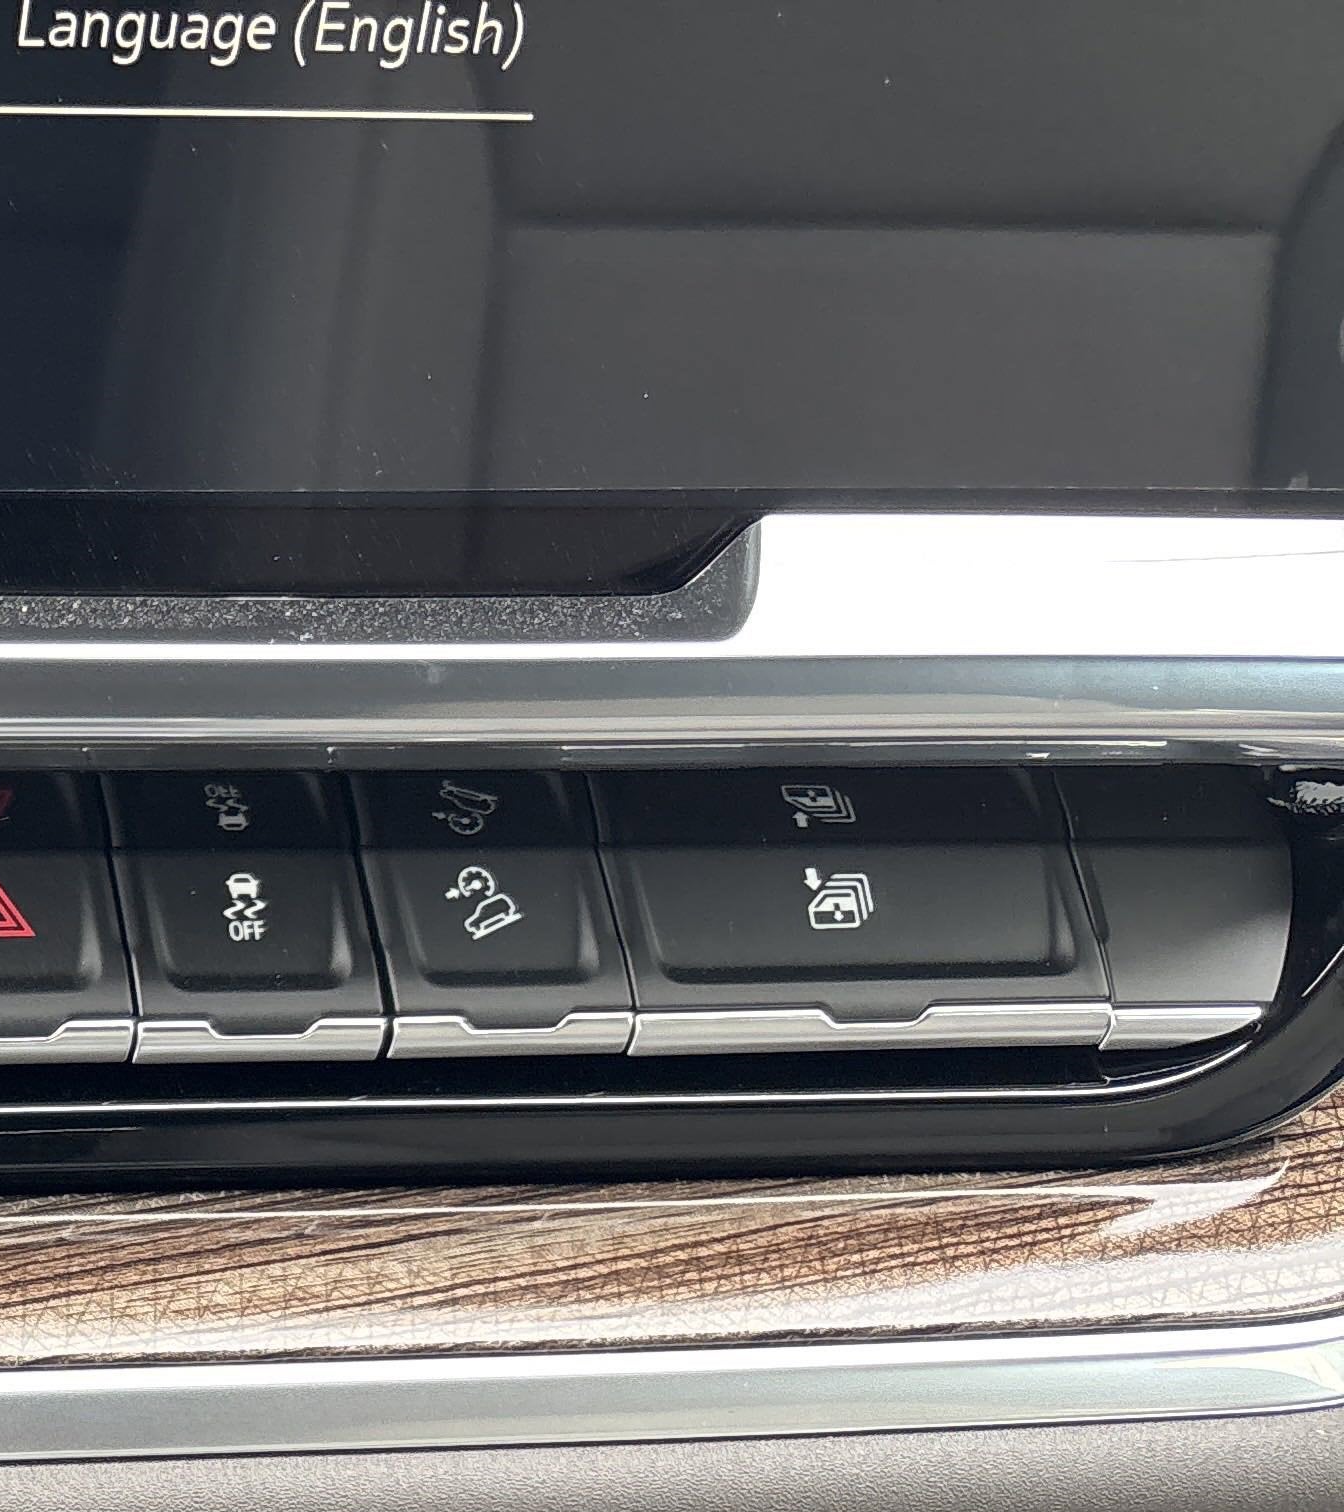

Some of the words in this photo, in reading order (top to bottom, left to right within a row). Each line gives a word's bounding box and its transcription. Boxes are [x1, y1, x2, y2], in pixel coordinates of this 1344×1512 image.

[17, 0, 278, 67] Language
[293, 0, 526, 71] (English)
[228, 920, 267, 942] OFF
